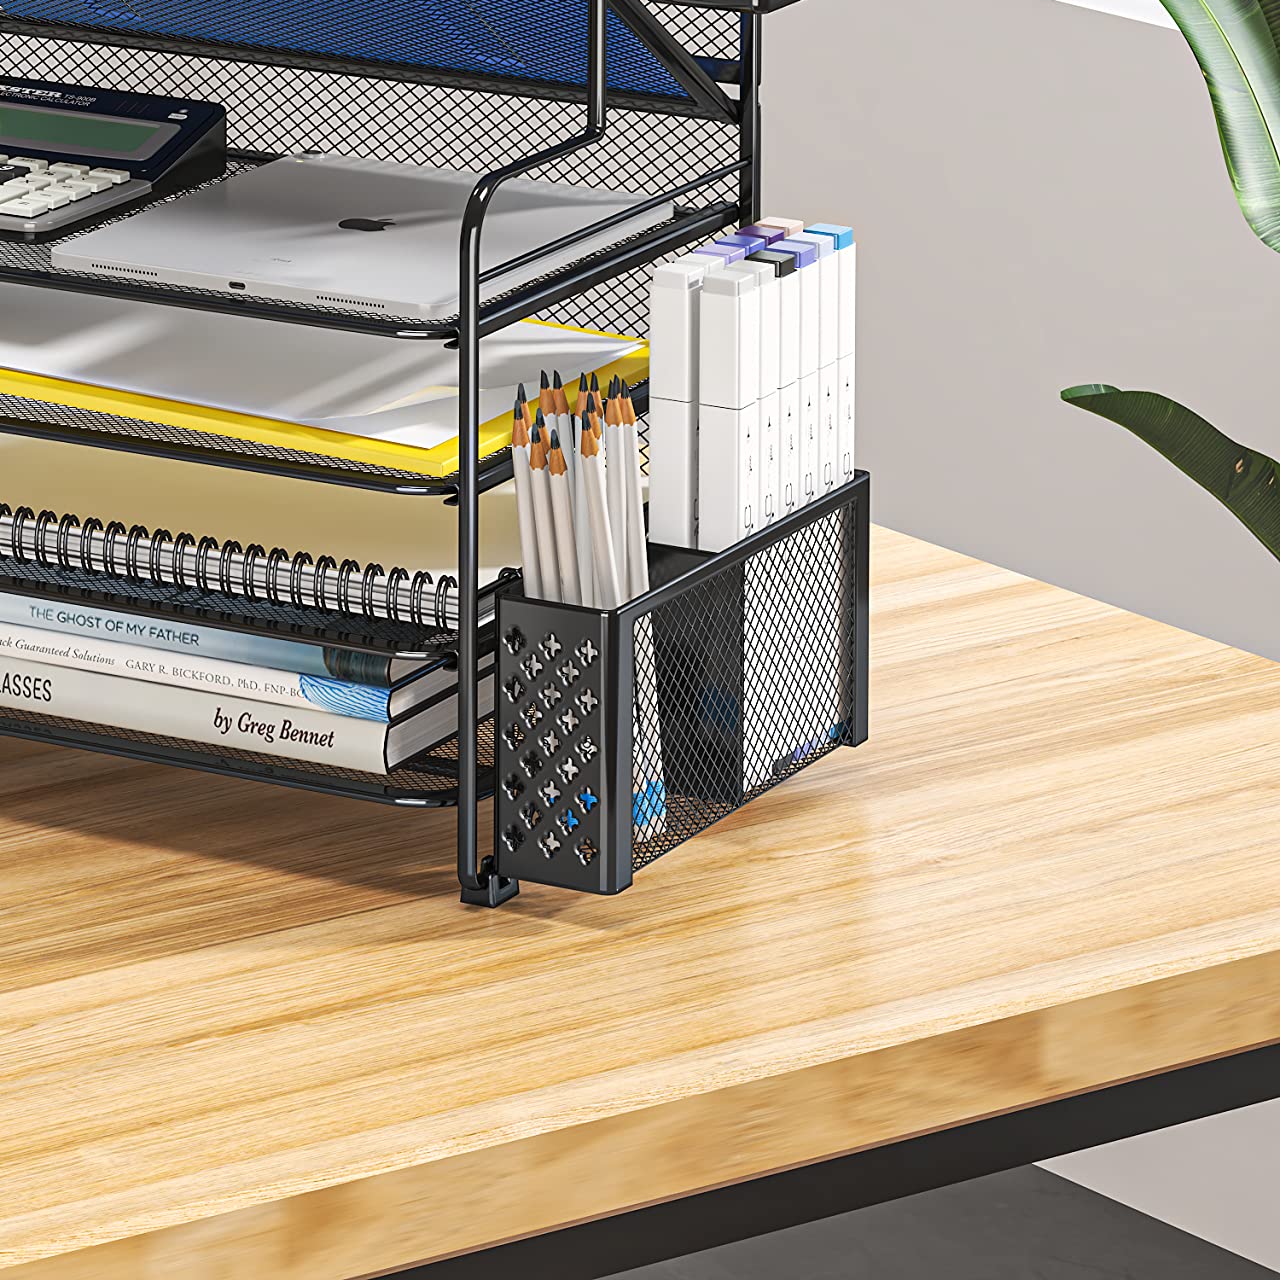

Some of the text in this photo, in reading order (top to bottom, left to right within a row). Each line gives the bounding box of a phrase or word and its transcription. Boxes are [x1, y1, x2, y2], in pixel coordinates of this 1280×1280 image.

[40, 96, 91, 107] CALCULATOR
[29, 606, 200, 646] THE GHOST OF MY FATHER
[16, 639, 70, 658] Guaranteed
[72, 648, 115, 666] Solutions
[126, 659, 156, 674] GARY
[158, 665, 169, 675] R.
[172, 668, 234, 686] BICKFORD,
[214, 707, 334, 748] by Greg Bennet
